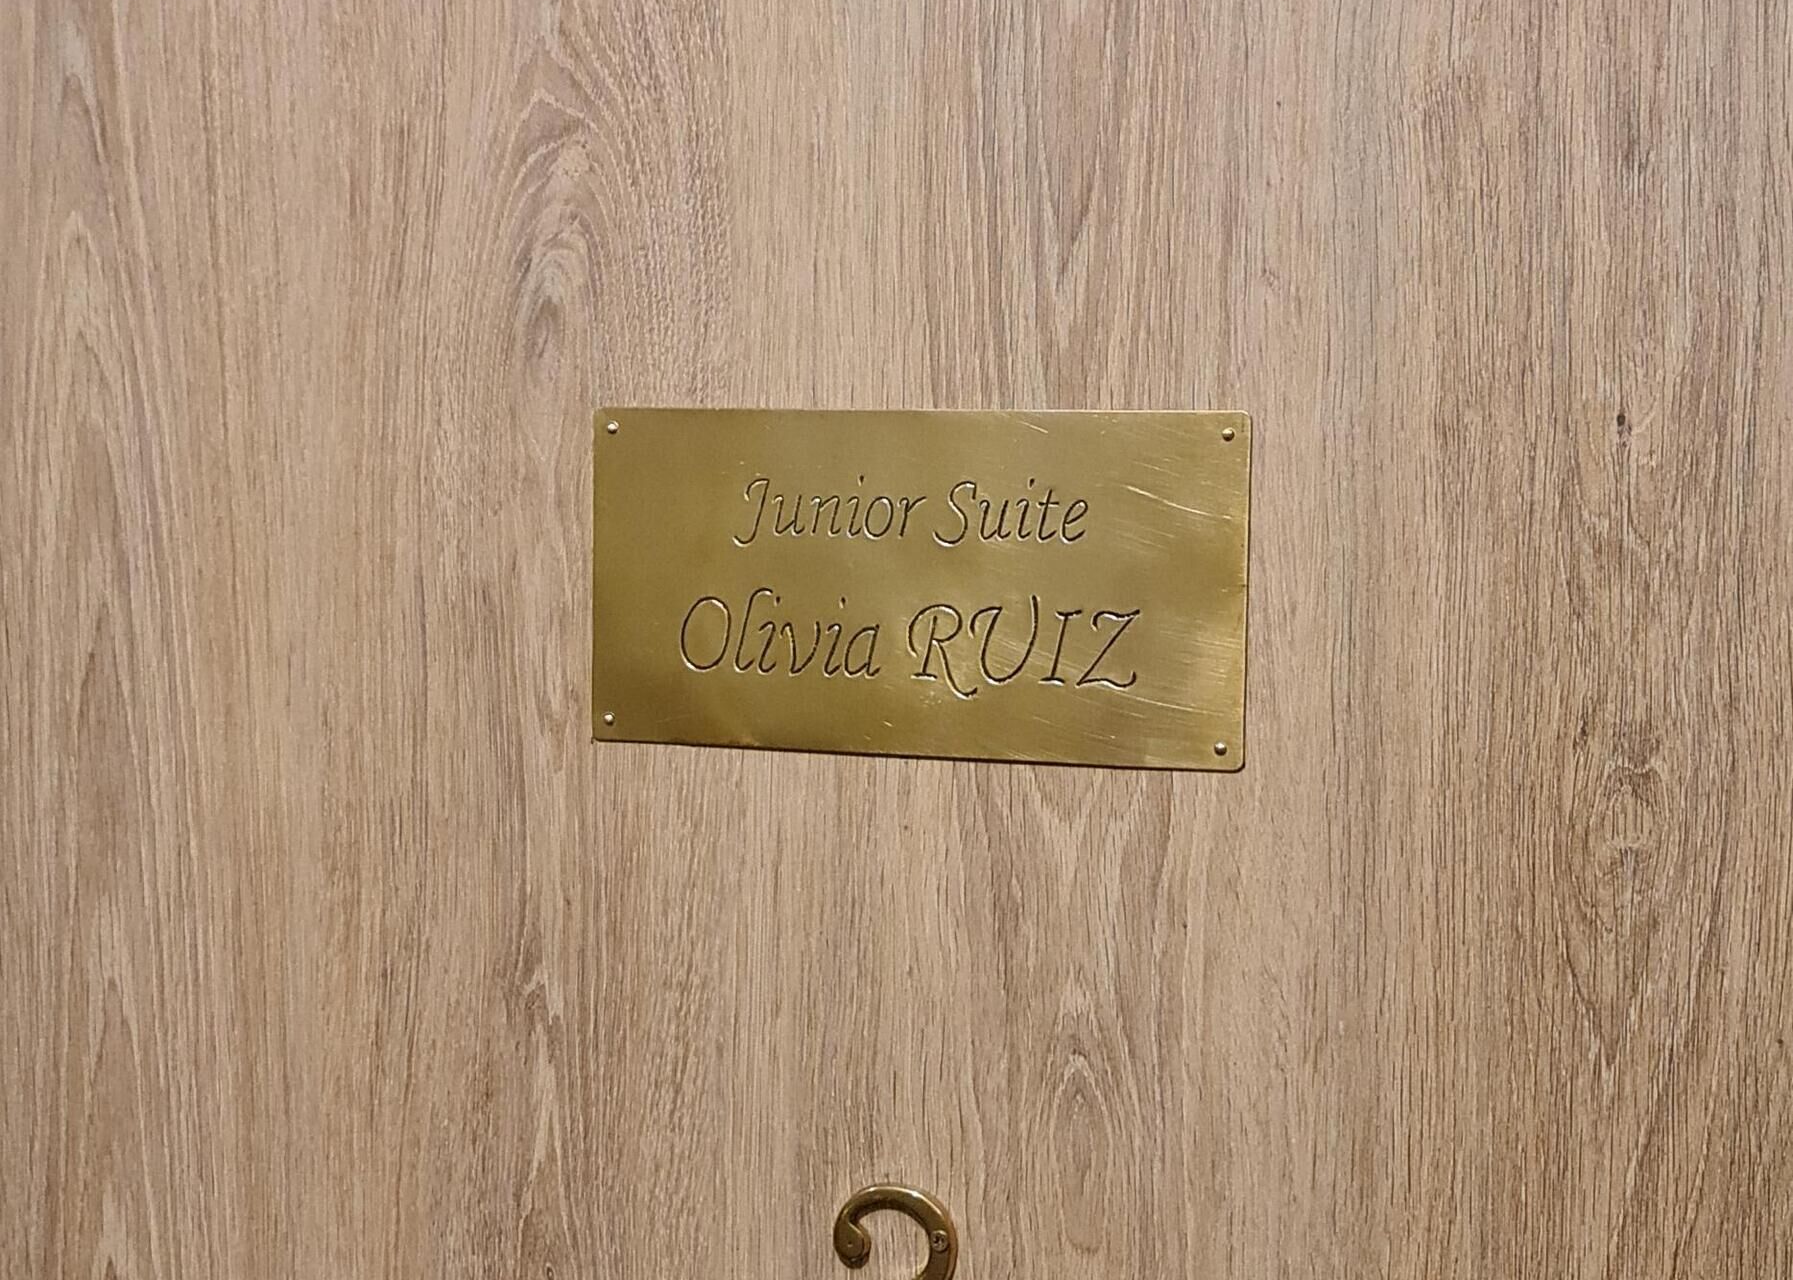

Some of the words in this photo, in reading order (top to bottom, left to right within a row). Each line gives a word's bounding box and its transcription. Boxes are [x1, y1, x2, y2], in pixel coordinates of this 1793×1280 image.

[733, 475, 926, 548] Junior
[932, 478, 1090, 549] Suite
[680, 587, 881, 679] Olivia
[907, 595, 1142, 700] RUIZ
